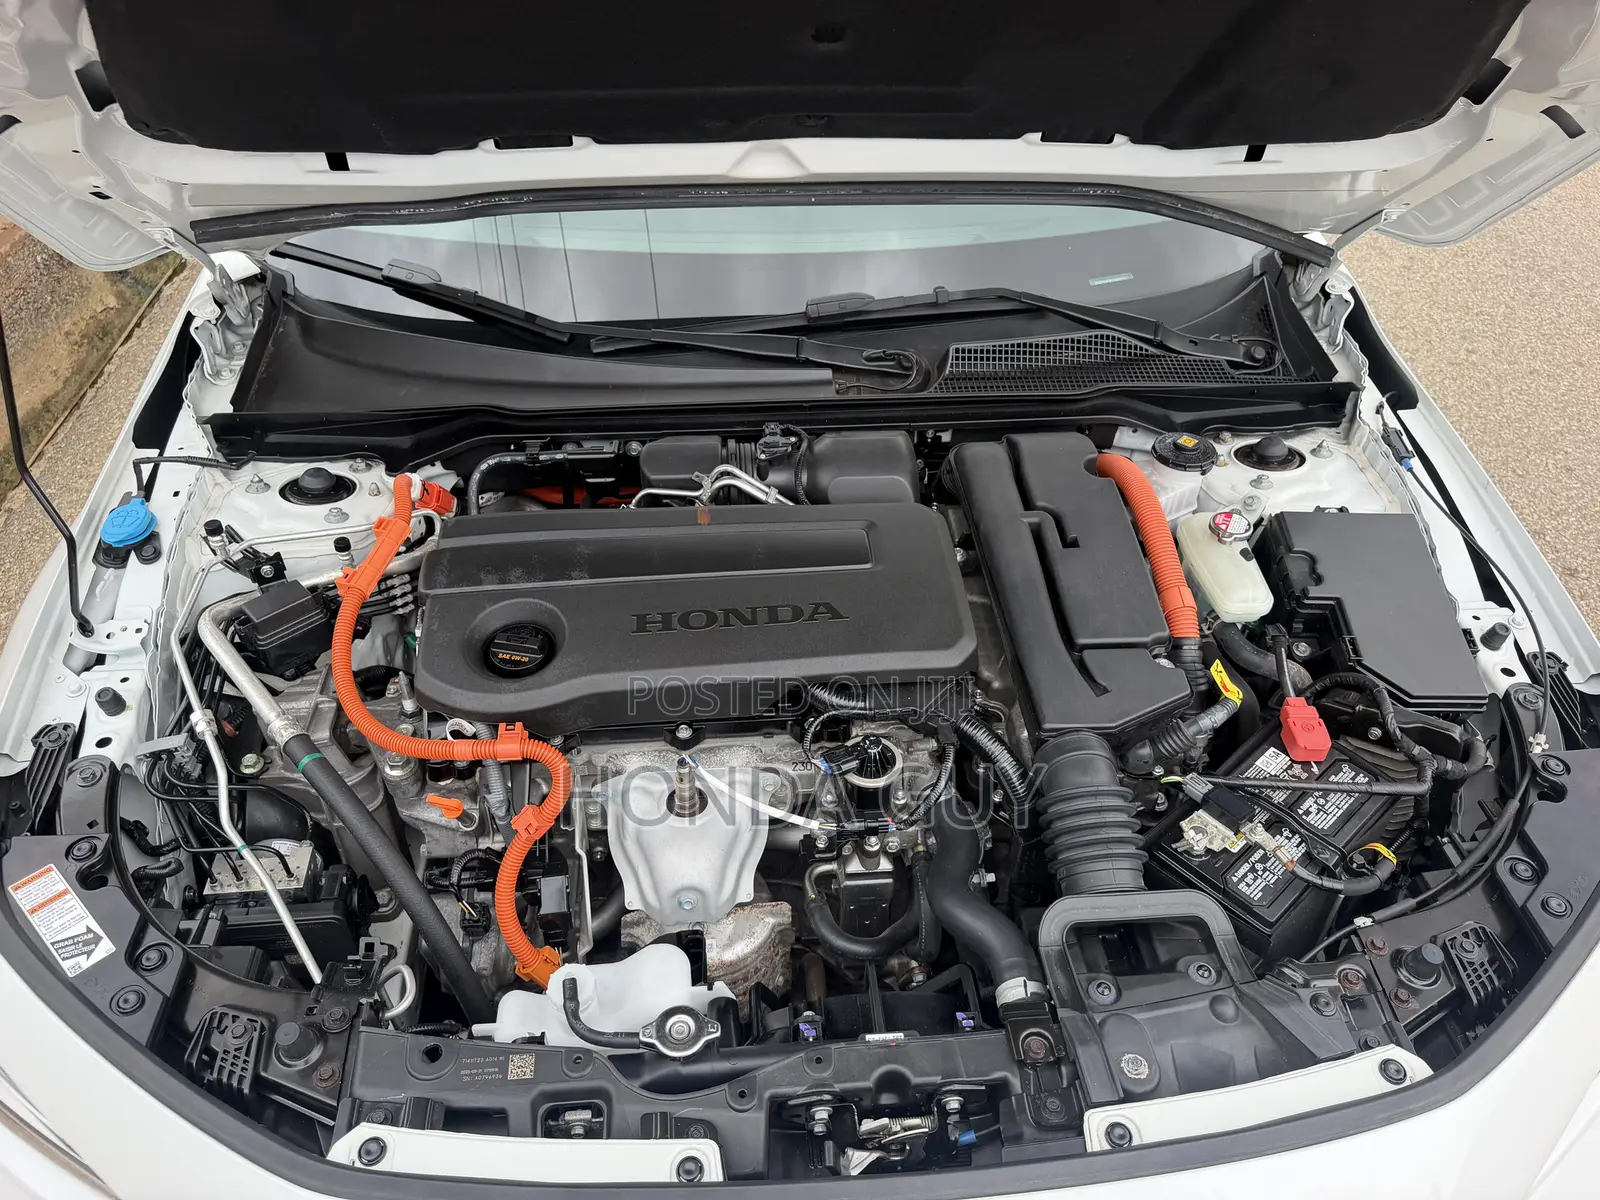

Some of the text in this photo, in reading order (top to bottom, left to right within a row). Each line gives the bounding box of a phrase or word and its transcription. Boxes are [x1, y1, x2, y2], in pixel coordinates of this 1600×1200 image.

[631, 602, 850, 635] HONDA
[792, 761, 813, 772] 230
[20, 867, 52, 886] WARNING
[54, 933, 94, 949] GRAB FOAM
[60, 944, 96, 959] PROTECTEUR
